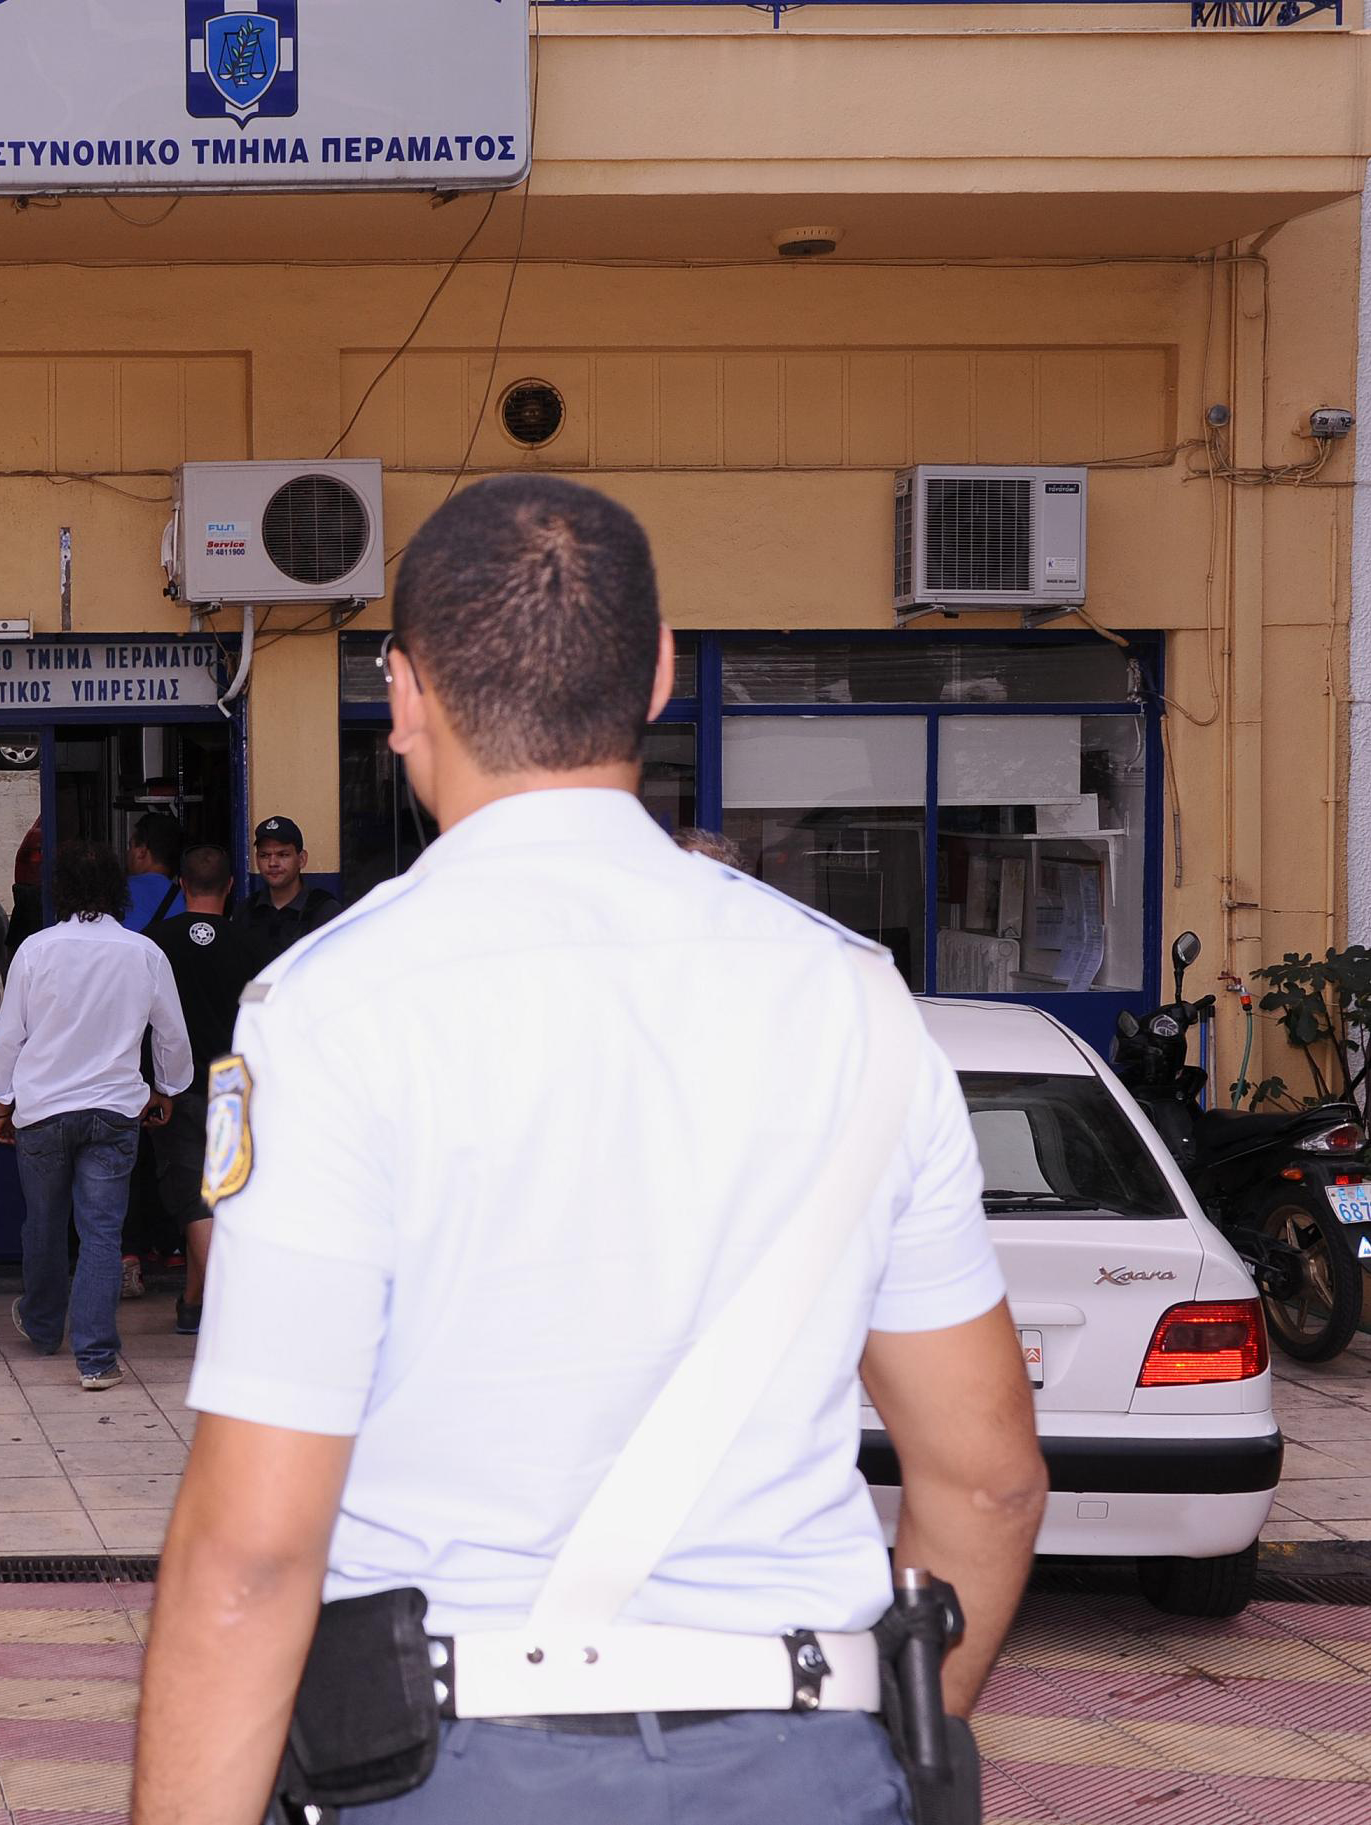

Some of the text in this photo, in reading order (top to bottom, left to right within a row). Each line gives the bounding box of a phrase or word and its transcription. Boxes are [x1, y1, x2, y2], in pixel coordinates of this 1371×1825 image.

[191, 137, 309, 165] ΤΜΗΜΑ
[321, 134, 516, 163] ΠΕΡΑΜΑΤΟΣ
[207, 540, 245, 548] Service
[27, 646, 92, 671] ΤΜΗΜΑ
[105, 644, 215, 669] ΠΕΡΑΜΑΤΟΣ
[71, 678, 180, 702] ΥΠΗΡΕΣΙΑΣ
[1339, 1202, 1371, 1222] 687
